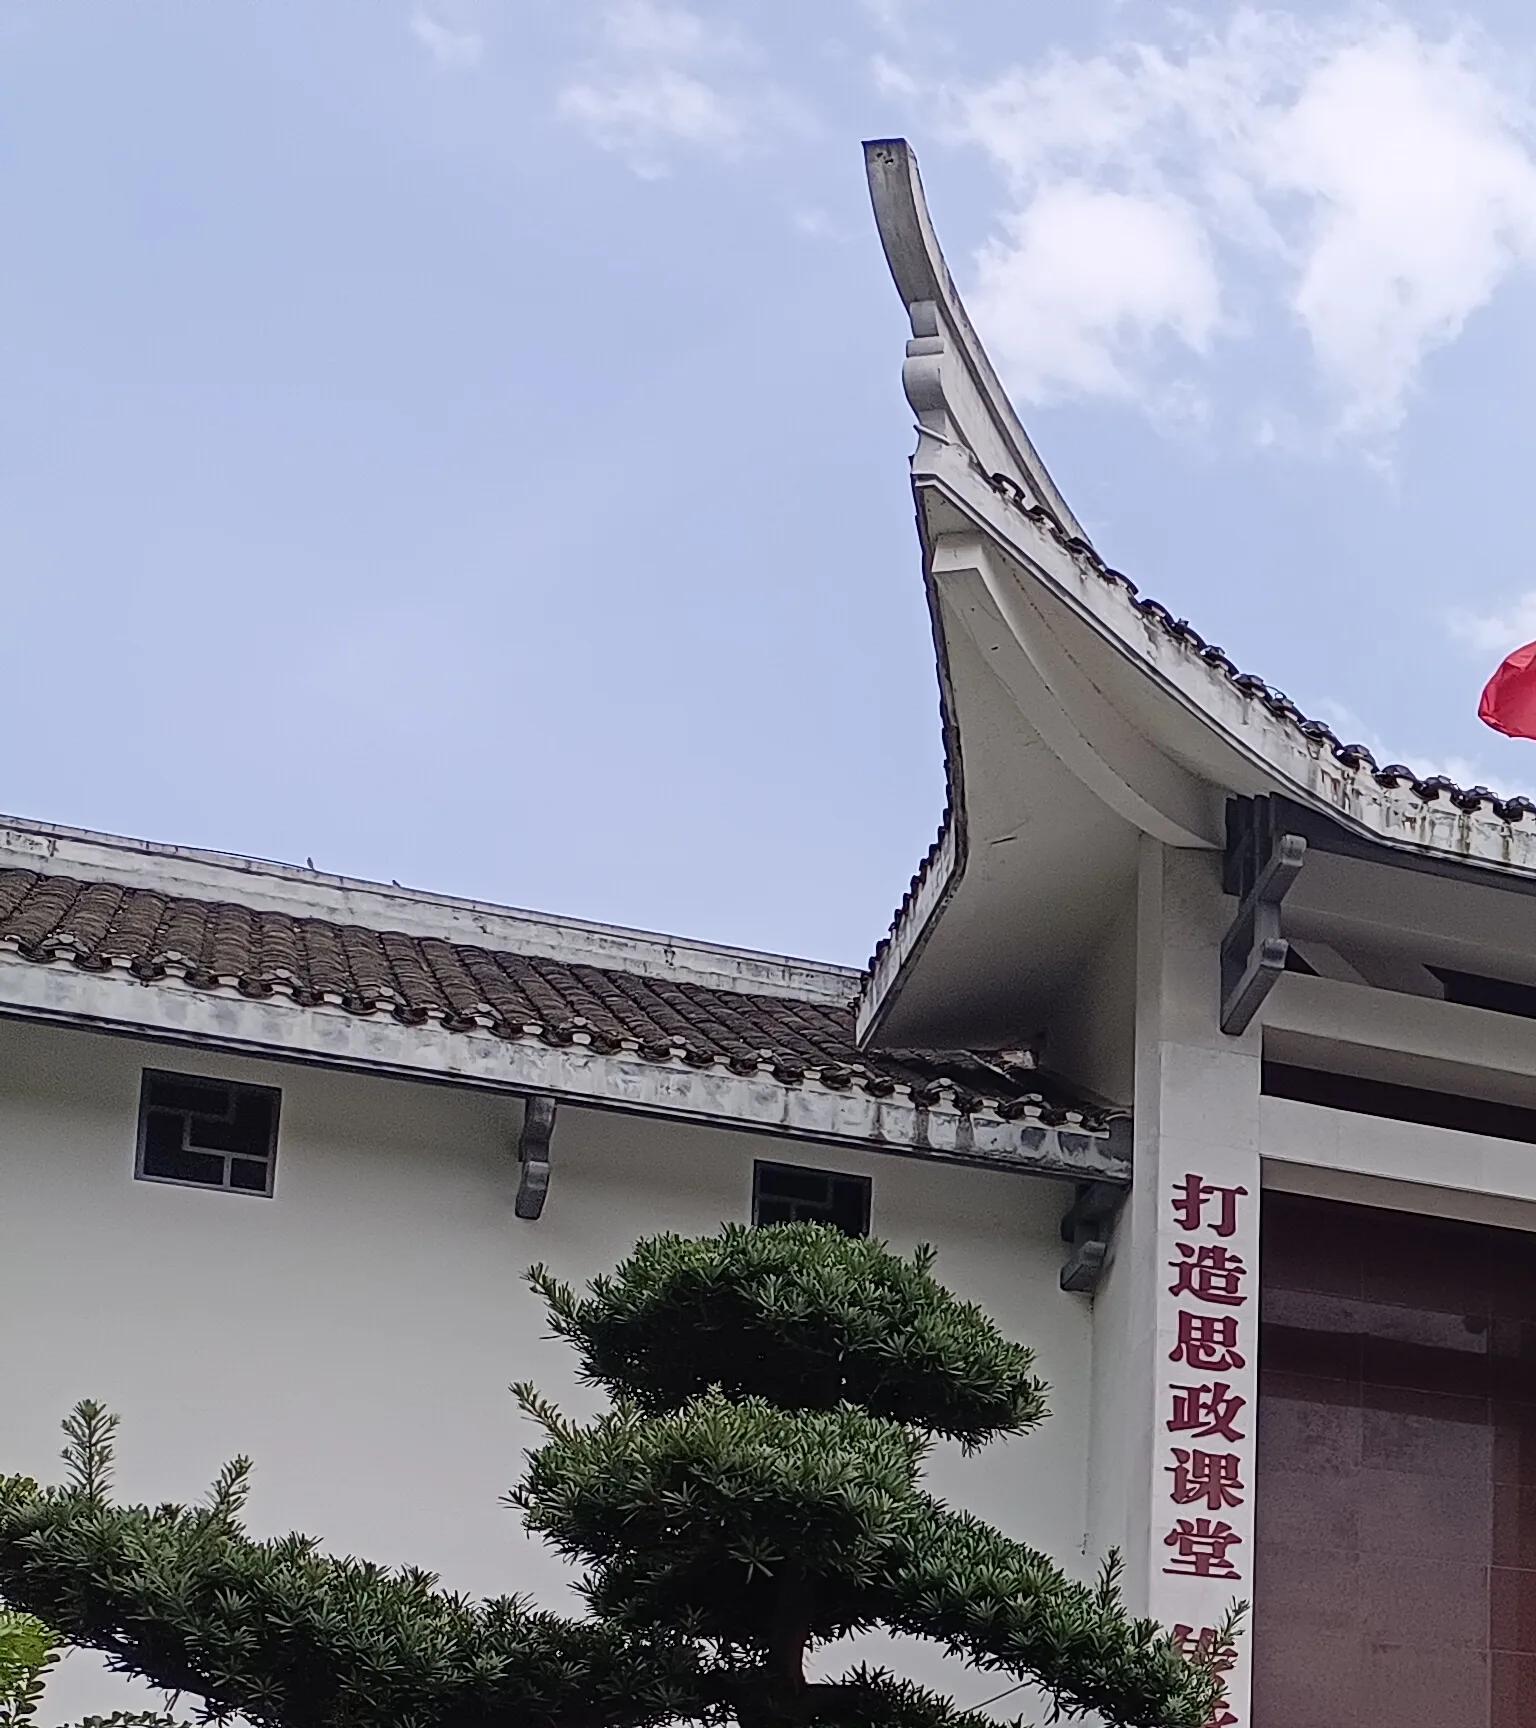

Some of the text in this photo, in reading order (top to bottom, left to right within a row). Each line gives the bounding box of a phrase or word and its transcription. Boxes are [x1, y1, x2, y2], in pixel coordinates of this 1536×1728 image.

[1162, 1172, 1249, 1580] 打造思政课堂
